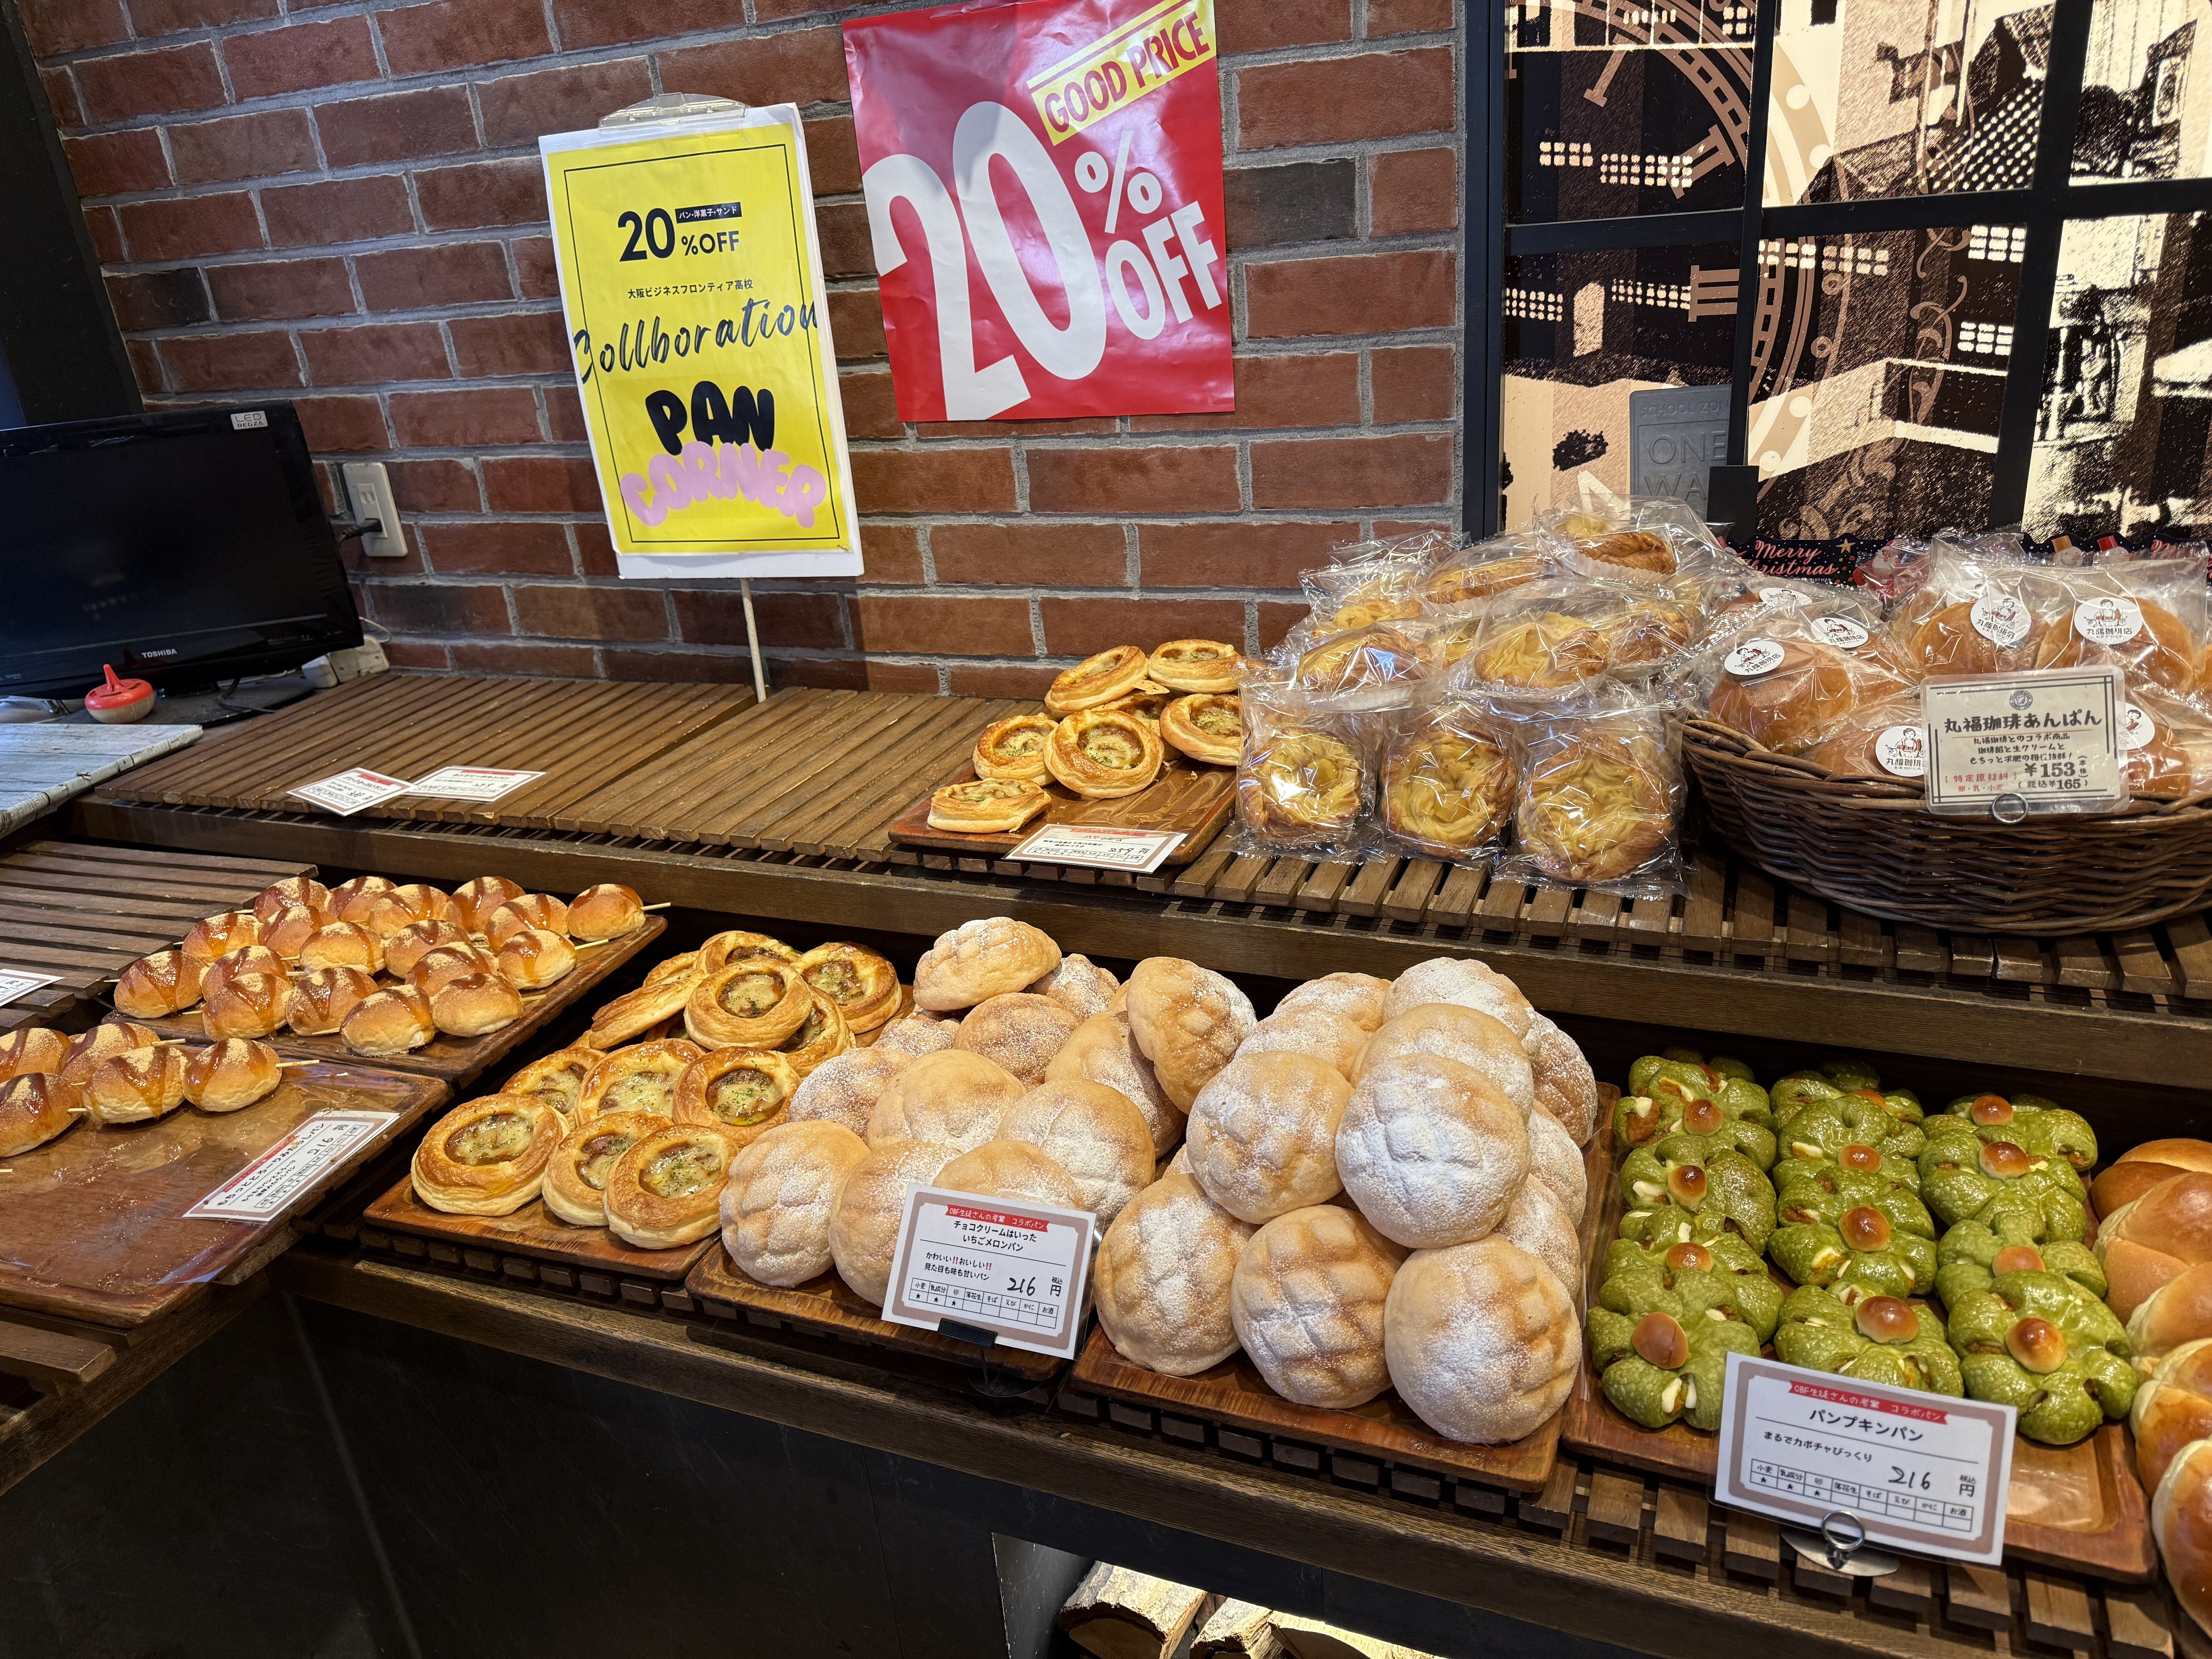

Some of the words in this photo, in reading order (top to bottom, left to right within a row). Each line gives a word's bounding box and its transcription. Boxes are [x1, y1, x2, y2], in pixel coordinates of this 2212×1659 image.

[1044, 61, 1127, 132] GOOD
[1127, 11, 1211, 89] PRICE
[1075, 131, 1162, 234] %
[618, 208, 675, 262] 20
[682, 230, 739, 256] %OFF
[862, 101, 1106, 421] 20
[1105, 201, 1222, 340] OFF
[628, 278, 753, 299] 大阪ビジネスフロンティア高校
[235, 413, 261, 422] LED
[645, 381, 776, 456] PAN
[1640, 404, 1695, 417] SCHOOL
[1700, 399, 1729, 413] ZON
[1649, 431, 1726, 464] ONE
[620, 441, 826, 528] CORNER
[1644, 472, 1707, 501] WA
[1755, 540, 1822, 565] Merry
[141, 648, 178, 659] TOSHIBA
[1944, 708, 2102, 733] 丸福珈琲あんぱん
[1973, 733, 2070, 745] 丸福珈琲とのコラボ商品
[1885, 757, 1924, 767] 丸福珈琲
[2025, 762, 2076, 778] ¥153
[307, 1137, 333, 1155] 216
[949, 1207, 1006, 1223] OBF生徒さんの考案
[1012, 1217, 1044, 1229] コラボパン
[954, 1220, 1037, 1242] チョコクリームはいった
[963, 1235, 1024, 1252] いちごメロンパン
[924, 1262, 989, 1281] 見た目も味も甘いパン
[1007, 1276, 1036, 1296] 216
[1050, 1285, 1062, 1297] 円
[1794, 1384, 1880, 1409] OBF生徒さんの考案
[1891, 1405, 1941, 1420] コラボパン
[1810, 1410, 1923, 1442] パンプキンパン
[1764, 1431, 1873, 1463] まるでカボチャびっくり
[1888, 1466, 1931, 1490] 216
[1959, 1484, 1975, 1498] 円
